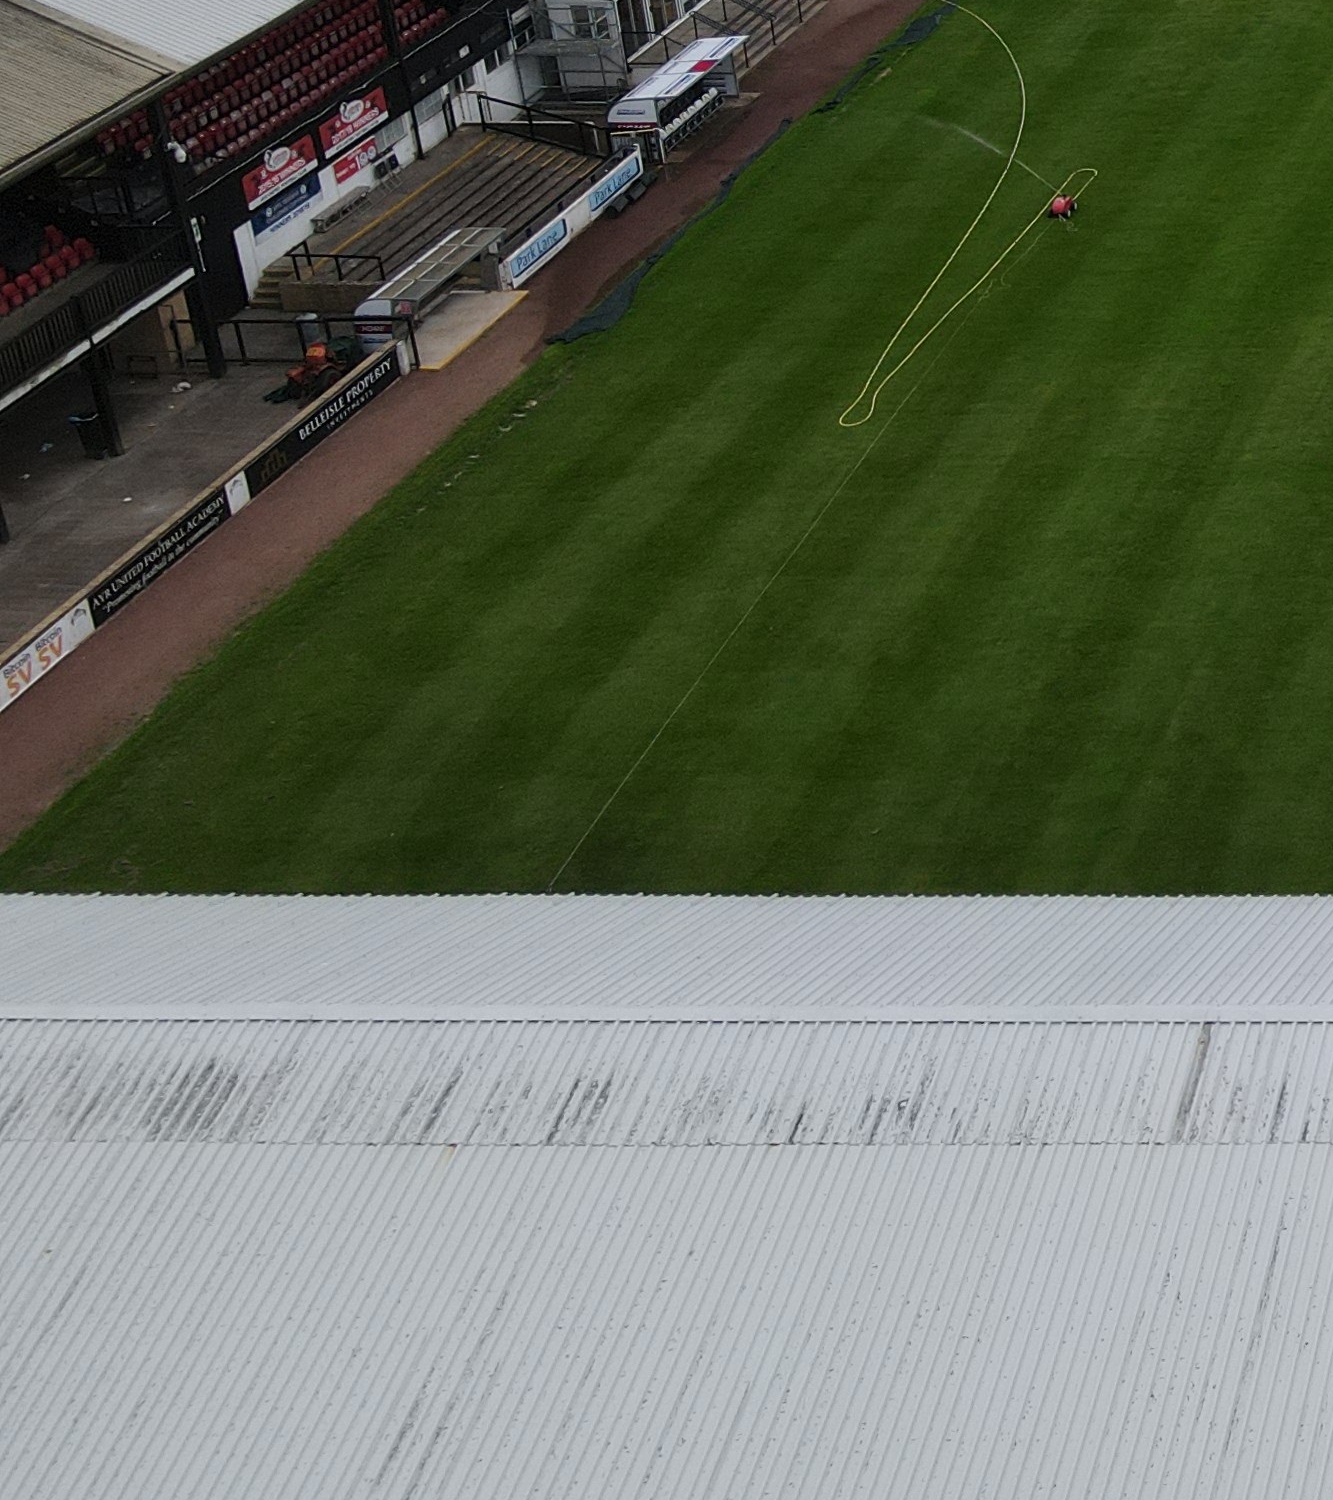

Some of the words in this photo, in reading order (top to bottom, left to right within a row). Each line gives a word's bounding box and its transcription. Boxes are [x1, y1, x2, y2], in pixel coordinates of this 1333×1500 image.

[594, 183, 613, 204] Park
[613, 168, 632, 191] Lane
[516, 246, 537, 271] Park
[538, 230, 558, 253] Lane
[299, 395, 346, 441] BELLEISLE
[346, 357, 393, 403] PROPERTY
[92, 586, 112, 609] AYR
[110, 562, 145, 593] UNITED
[144, 525, 187, 568] FOOTBALL
[186, 494, 226, 534] ACADEMY
[35, 627, 63, 652] Bitcoin
[38, 634, 64, 671] SV
[3, 653, 31, 679] Bitcoin
[7, 660, 32, 697] SV
